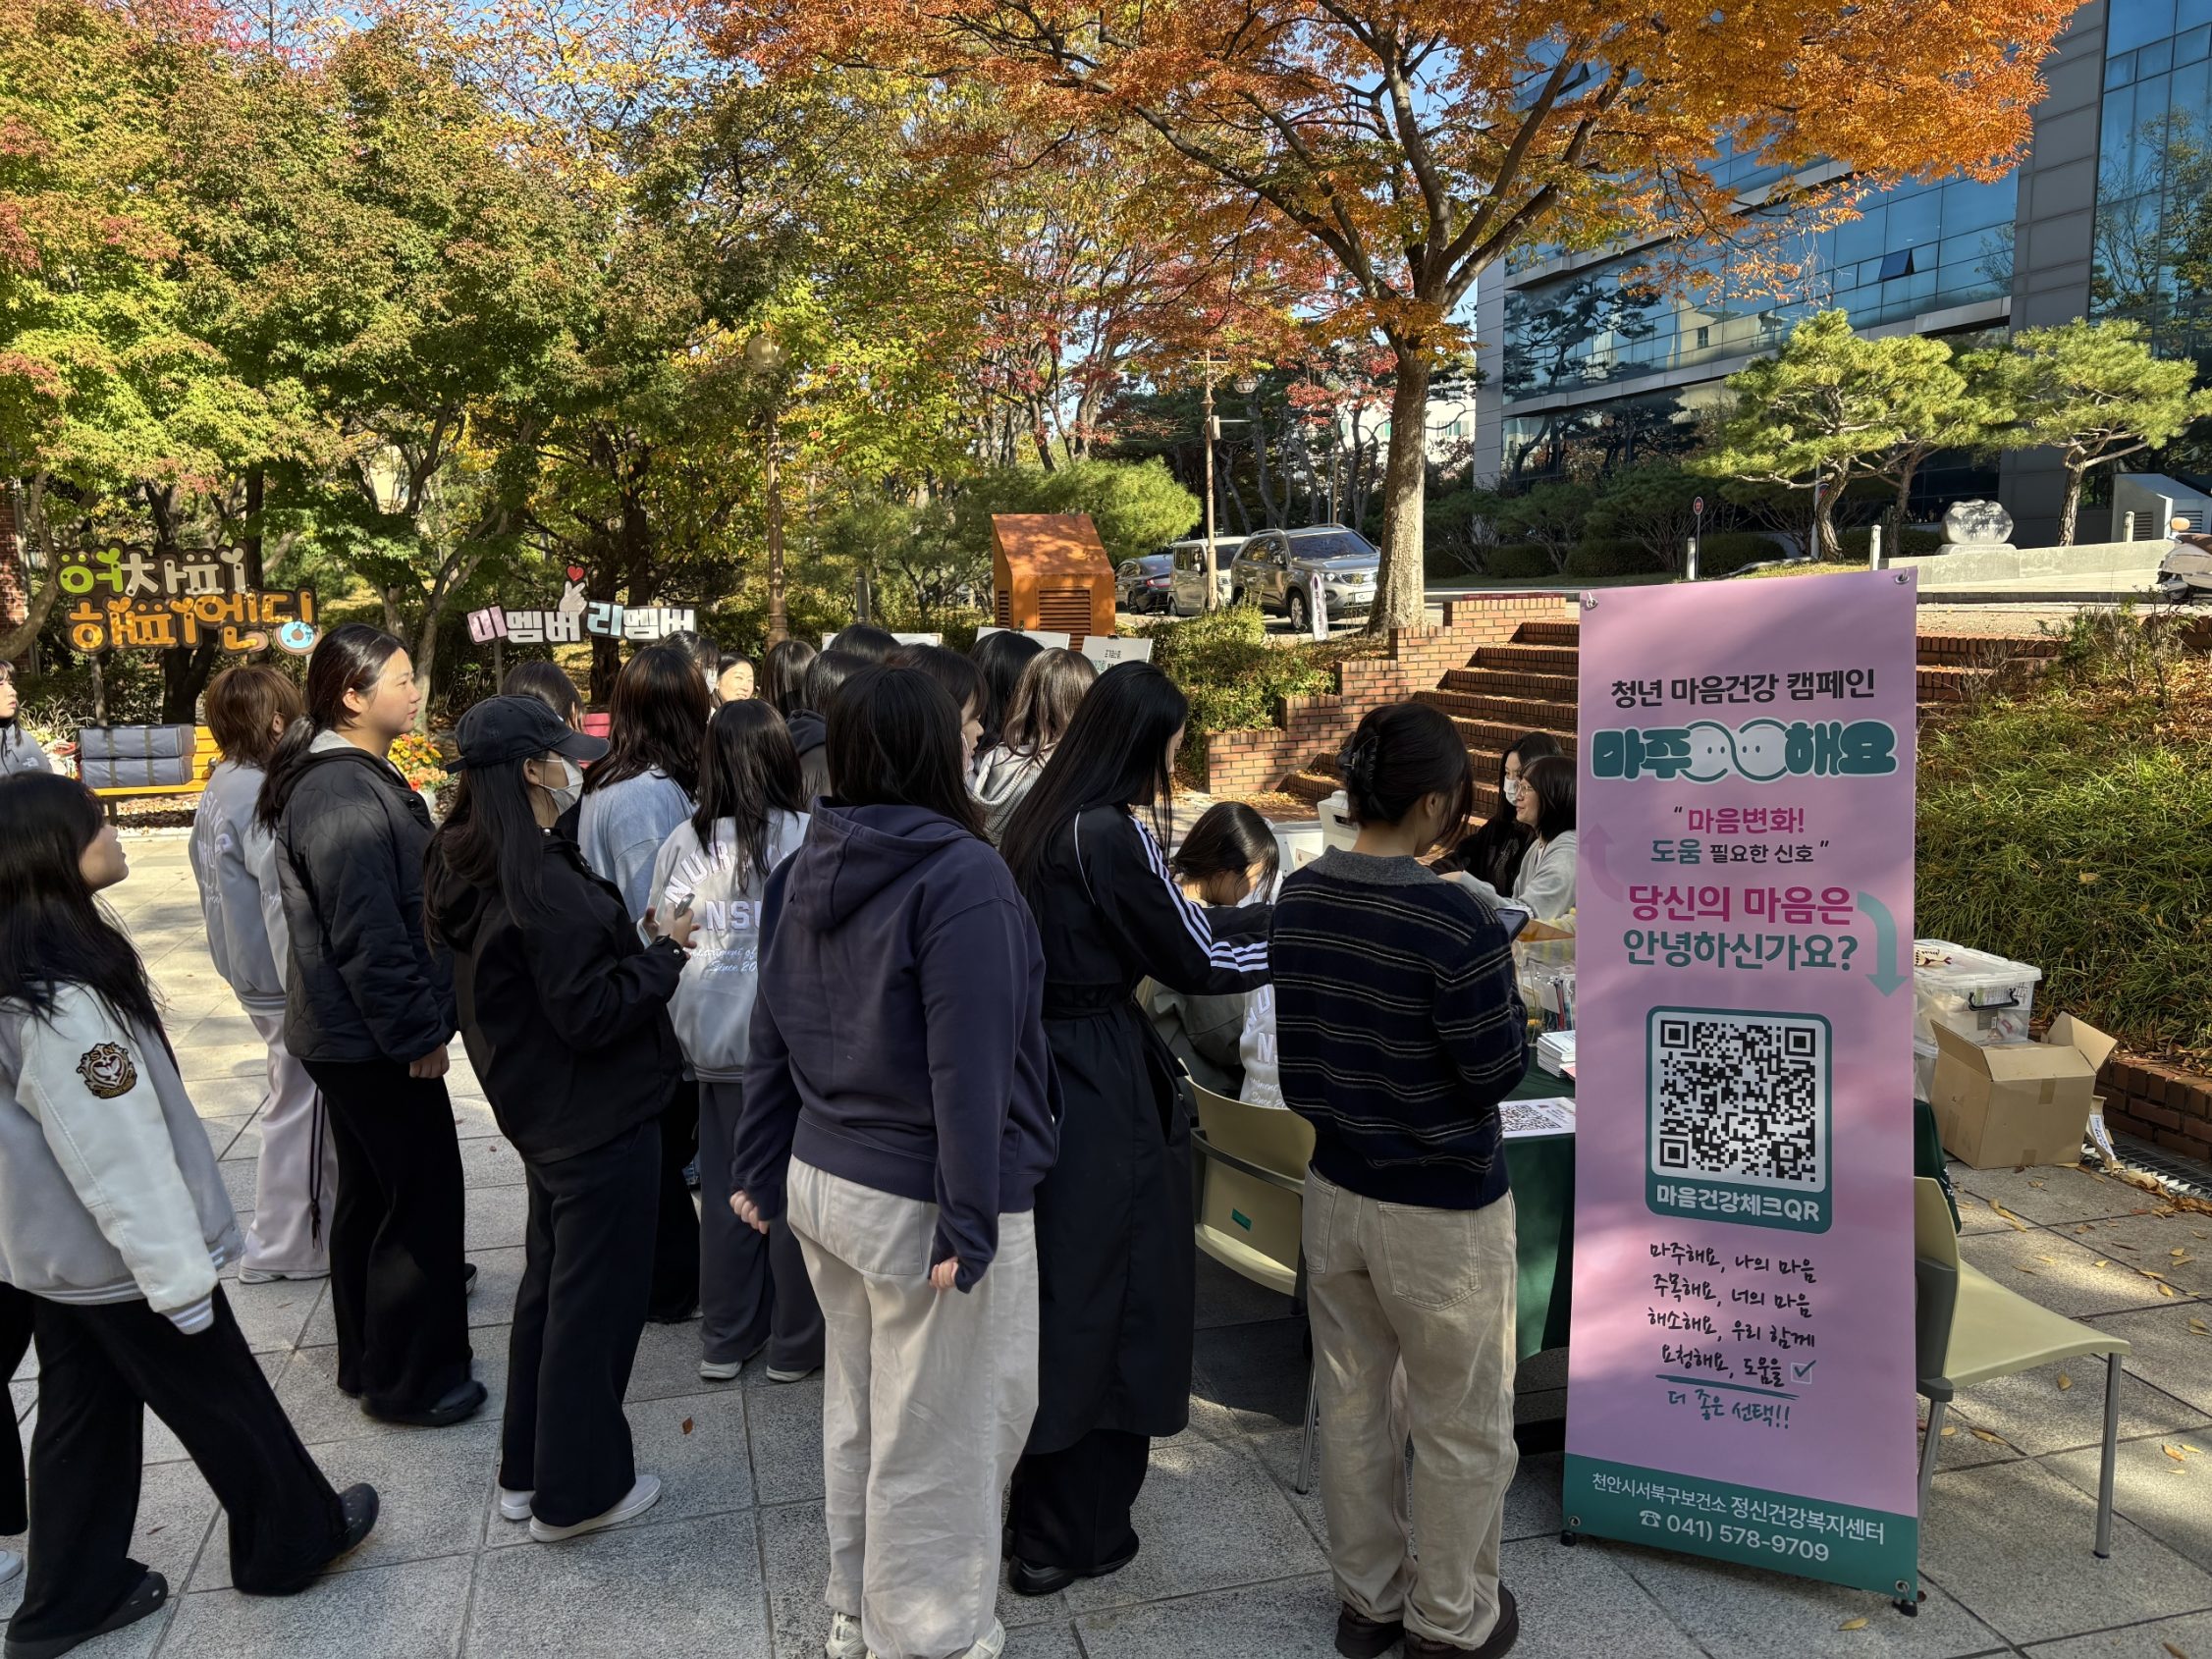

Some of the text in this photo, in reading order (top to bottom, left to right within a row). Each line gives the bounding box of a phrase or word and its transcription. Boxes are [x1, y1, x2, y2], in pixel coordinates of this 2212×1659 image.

[59, 547, 245, 597] 어차피
[69, 591, 320, 656] 해피엔딩
[1611, 669, 1874, 709] 청년 마음건강 캠페인
[1650, 838, 1702, 865] 도움
[1710, 844, 1769, 864] 필요한
[1629, 885, 1854, 926] 당신의 마음은
[1623, 930, 1859, 971] 안녕하신가요?
[1656, 1184, 1819, 1222] 마음건강체크QR
[1649, 1242, 1816, 1283] 마주해요, 나의 마음
[1653, 1272, 1812, 1318] 주목해요, 너의 마음
[1647, 1307, 1815, 1349] 해소해요, 우리 함께
[1662, 1344, 1785, 1387] 요청해요, 도움을
[1668, 1388, 1790, 1429] 더 좋은 선택!!
[1592, 1472, 1885, 1545] 천안시서북구보건소 정신건강복지센터
[1666, 1514, 1829, 1562] 041) 578-9709
